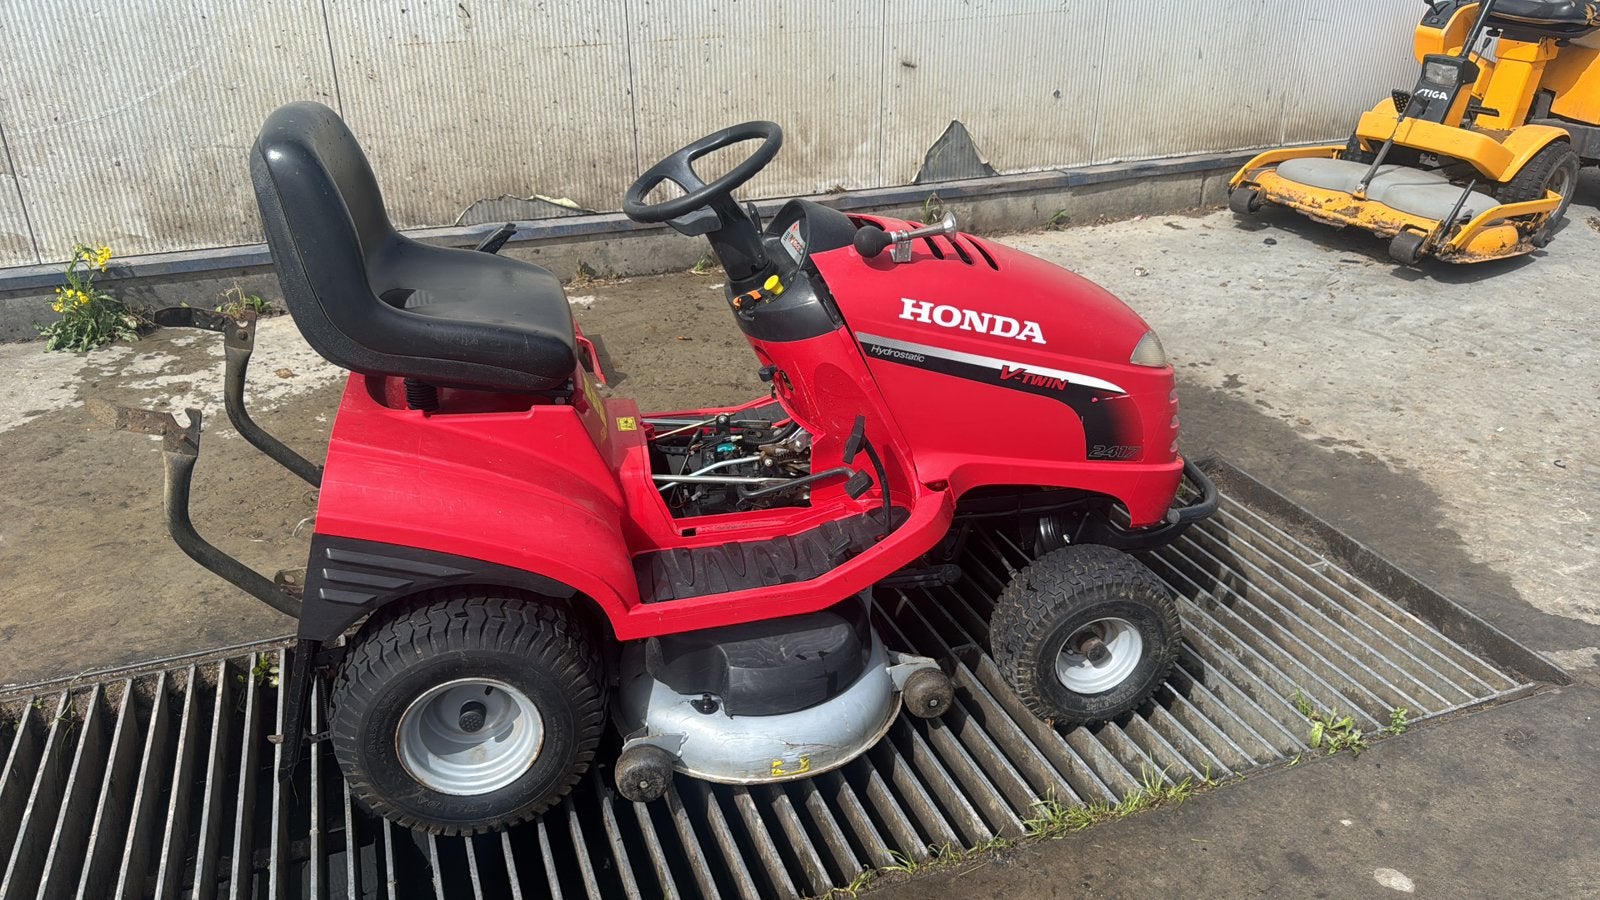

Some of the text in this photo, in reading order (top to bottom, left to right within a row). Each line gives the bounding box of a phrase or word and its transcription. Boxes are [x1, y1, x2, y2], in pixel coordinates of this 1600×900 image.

[1414, 88, 1448, 100] STIGA
[898, 297, 1047, 345] HONDA
[870, 344, 925, 363] Hydrostatic
[999, 365, 1069, 391] V-TWIN
[1087, 446, 1142, 459] 2417
